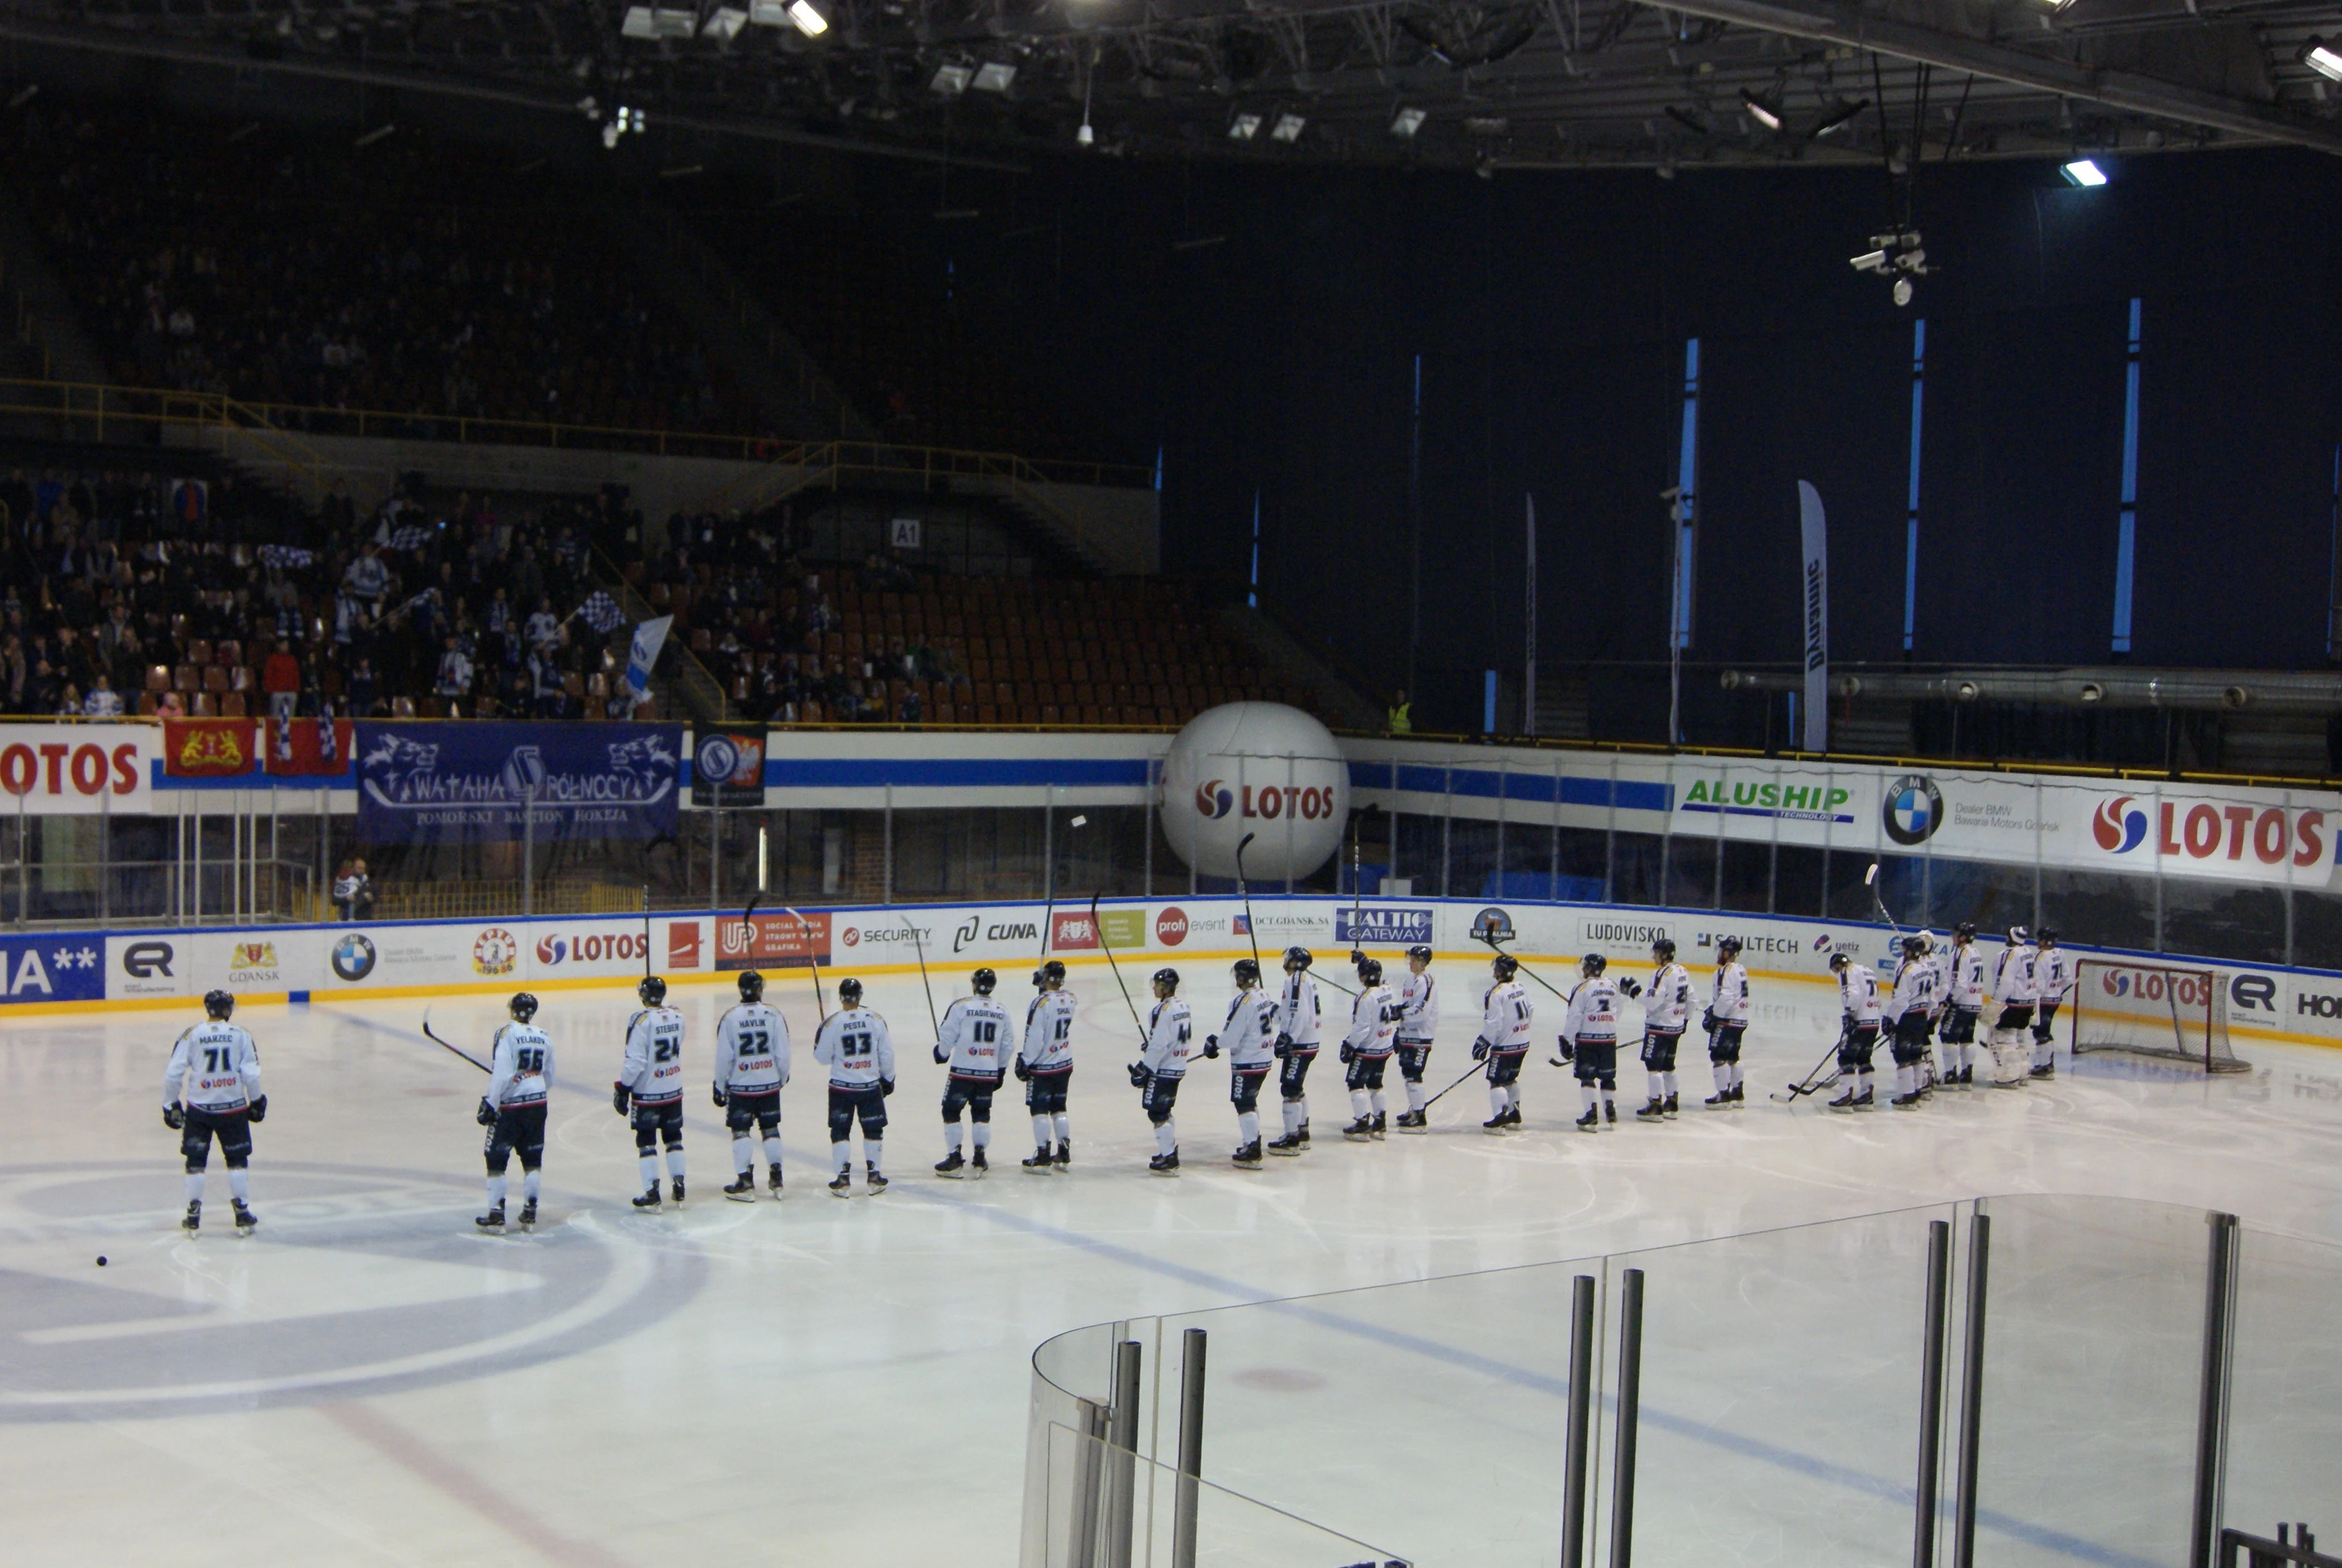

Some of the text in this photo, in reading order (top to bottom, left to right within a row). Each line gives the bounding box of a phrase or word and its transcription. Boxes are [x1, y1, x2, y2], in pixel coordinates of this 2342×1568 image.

[897, 524, 916, 543] A1
[415, 772, 630, 800] WATAHA PÓŁNOCY
[1242, 785, 1334, 819] LOTOS
[1686, 779, 1849, 811] ALUSHIP
[416, 809, 628, 825] POMORSKI BATION HOKEJA
[1780, 810, 1838, 822] TECHNOLOGY
[1956, 802, 2012, 816] Dealer BMW
[1991, 817, 2023, 830] Motors
[2160, 801, 2324, 867] LOTOS
[1159, 918, 1225, 934] profi event
[1347, 911, 1427, 928] BALTIC
[864, 928, 932, 942] SECURITY
[987, 922, 1038, 941] CUNA
[1347, 928, 1425, 940] GATEWAY
[1587, 923, 1665, 942] LUDOVISKO
[573, 933, 647, 961] LOTOS
[765, 943, 801, 951] GRAFIKA
[1835, 941, 1860, 952] yetiz
[229, 970, 279, 983] GDAŃSK
[2133, 972, 2211, 1007] LOTOS
[655, 1023, 679, 1034] STEBER
[739, 1018, 766, 1029] HAVLIK
[974, 1020, 997, 1043] 10
[200, 1034, 232, 1044] MARZEC
[738, 1030, 770, 1057] 22
[842, 1031, 872, 1057] 93
[1644, 1034, 1657, 1059] LOTOS
[203, 1046, 232, 1074] 71
[979, 1048, 995, 1057] LOTO
[750, 1059, 773, 1070] LOTOS
[213, 1077, 237, 1088] LOTOS
[1145, 1076, 1157, 1105] LOTOS
[1234, 1075, 1243, 1099] OTOS
